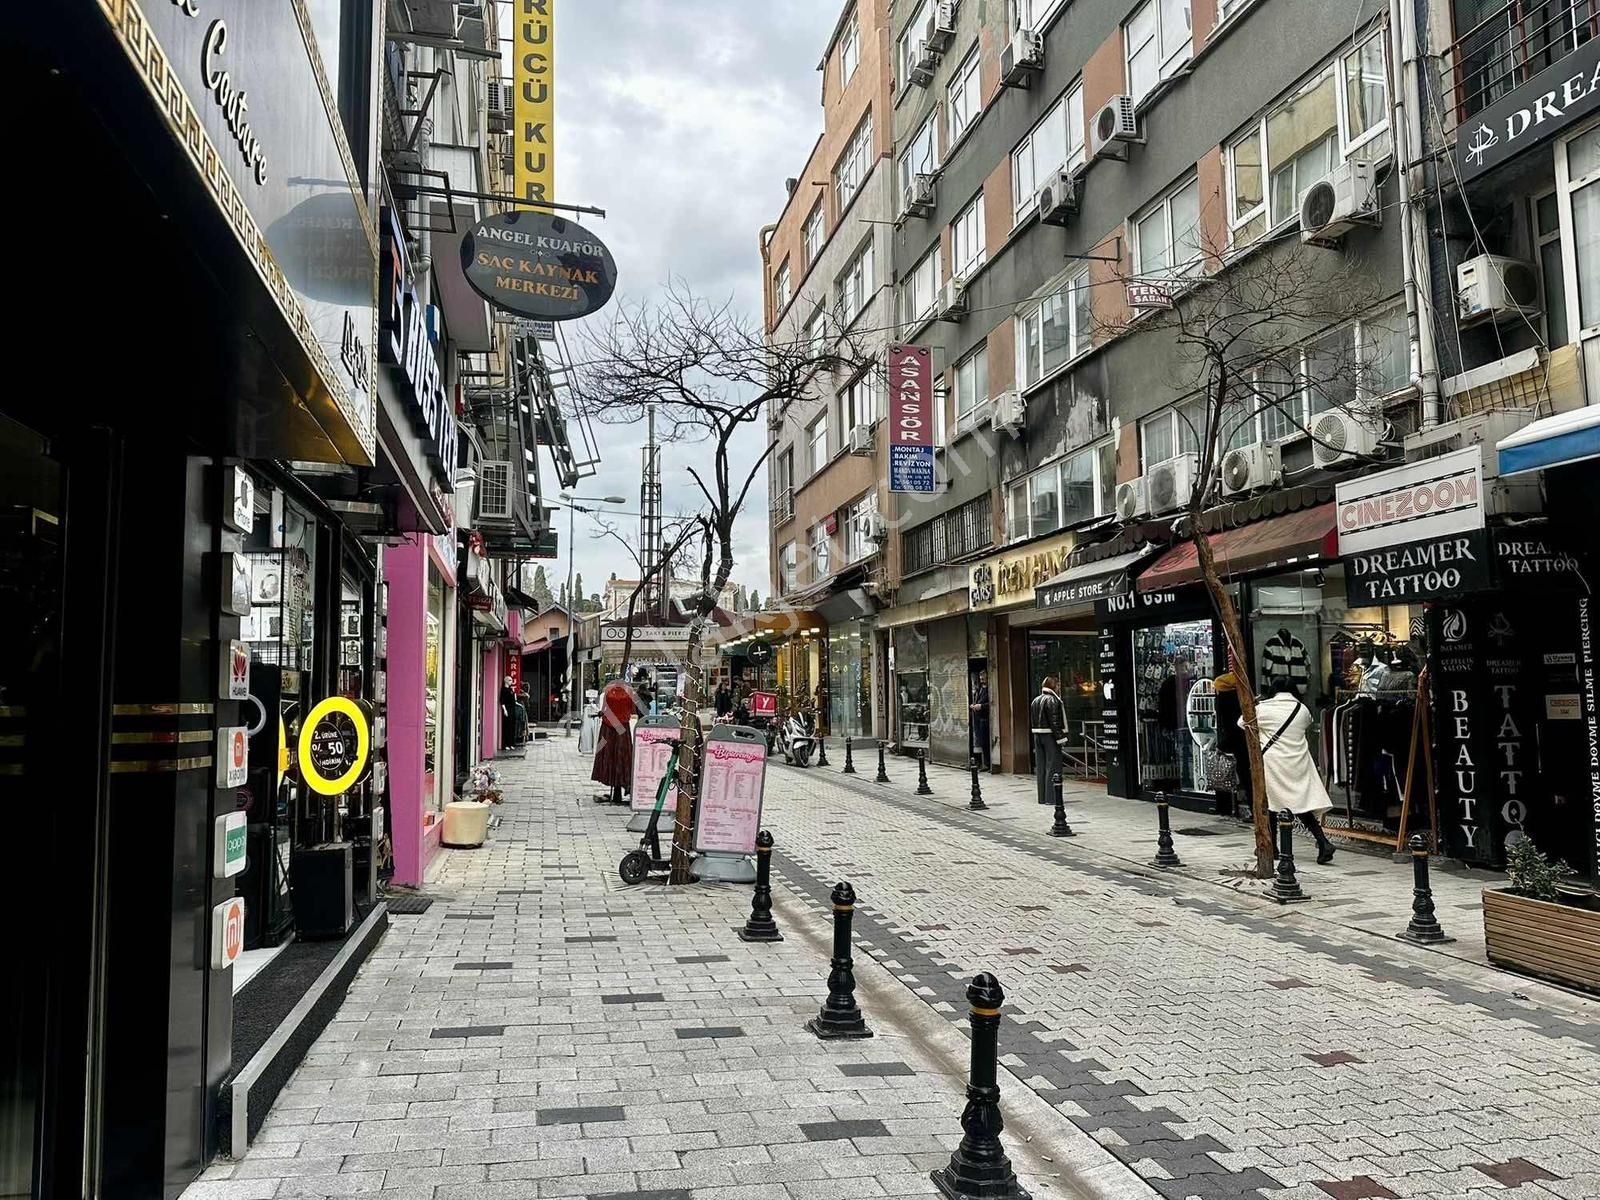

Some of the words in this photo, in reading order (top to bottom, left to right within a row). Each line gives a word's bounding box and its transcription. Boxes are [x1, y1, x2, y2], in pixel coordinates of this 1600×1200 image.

[477, 225, 534, 247] ANGEL
[536, 235, 604, 258] KUAFÖR
[477, 251, 514, 273] SAÇ
[519, 259, 599, 285] KAYNAK
[495, 275, 580, 301] MERKEZİ
[899, 355, 922, 442] ASANSÖR
[1340, 475, 1478, 530] CINEZOOM
[1352, 537, 1477, 577] DREAMER
[1507, 557, 1580, 574] TATTOO
[1053, 588, 1075, 603] APPLE
[1078, 583, 1103, 598] STORE
[1365, 567, 1461, 600] TATTOO
[1107, 589, 1136, 613] NO.1
[1579, 597, 1593, 663] PIERCING
[328, 740, 343, 756] 50
[1451, 689, 1479, 848] BEAUTY
